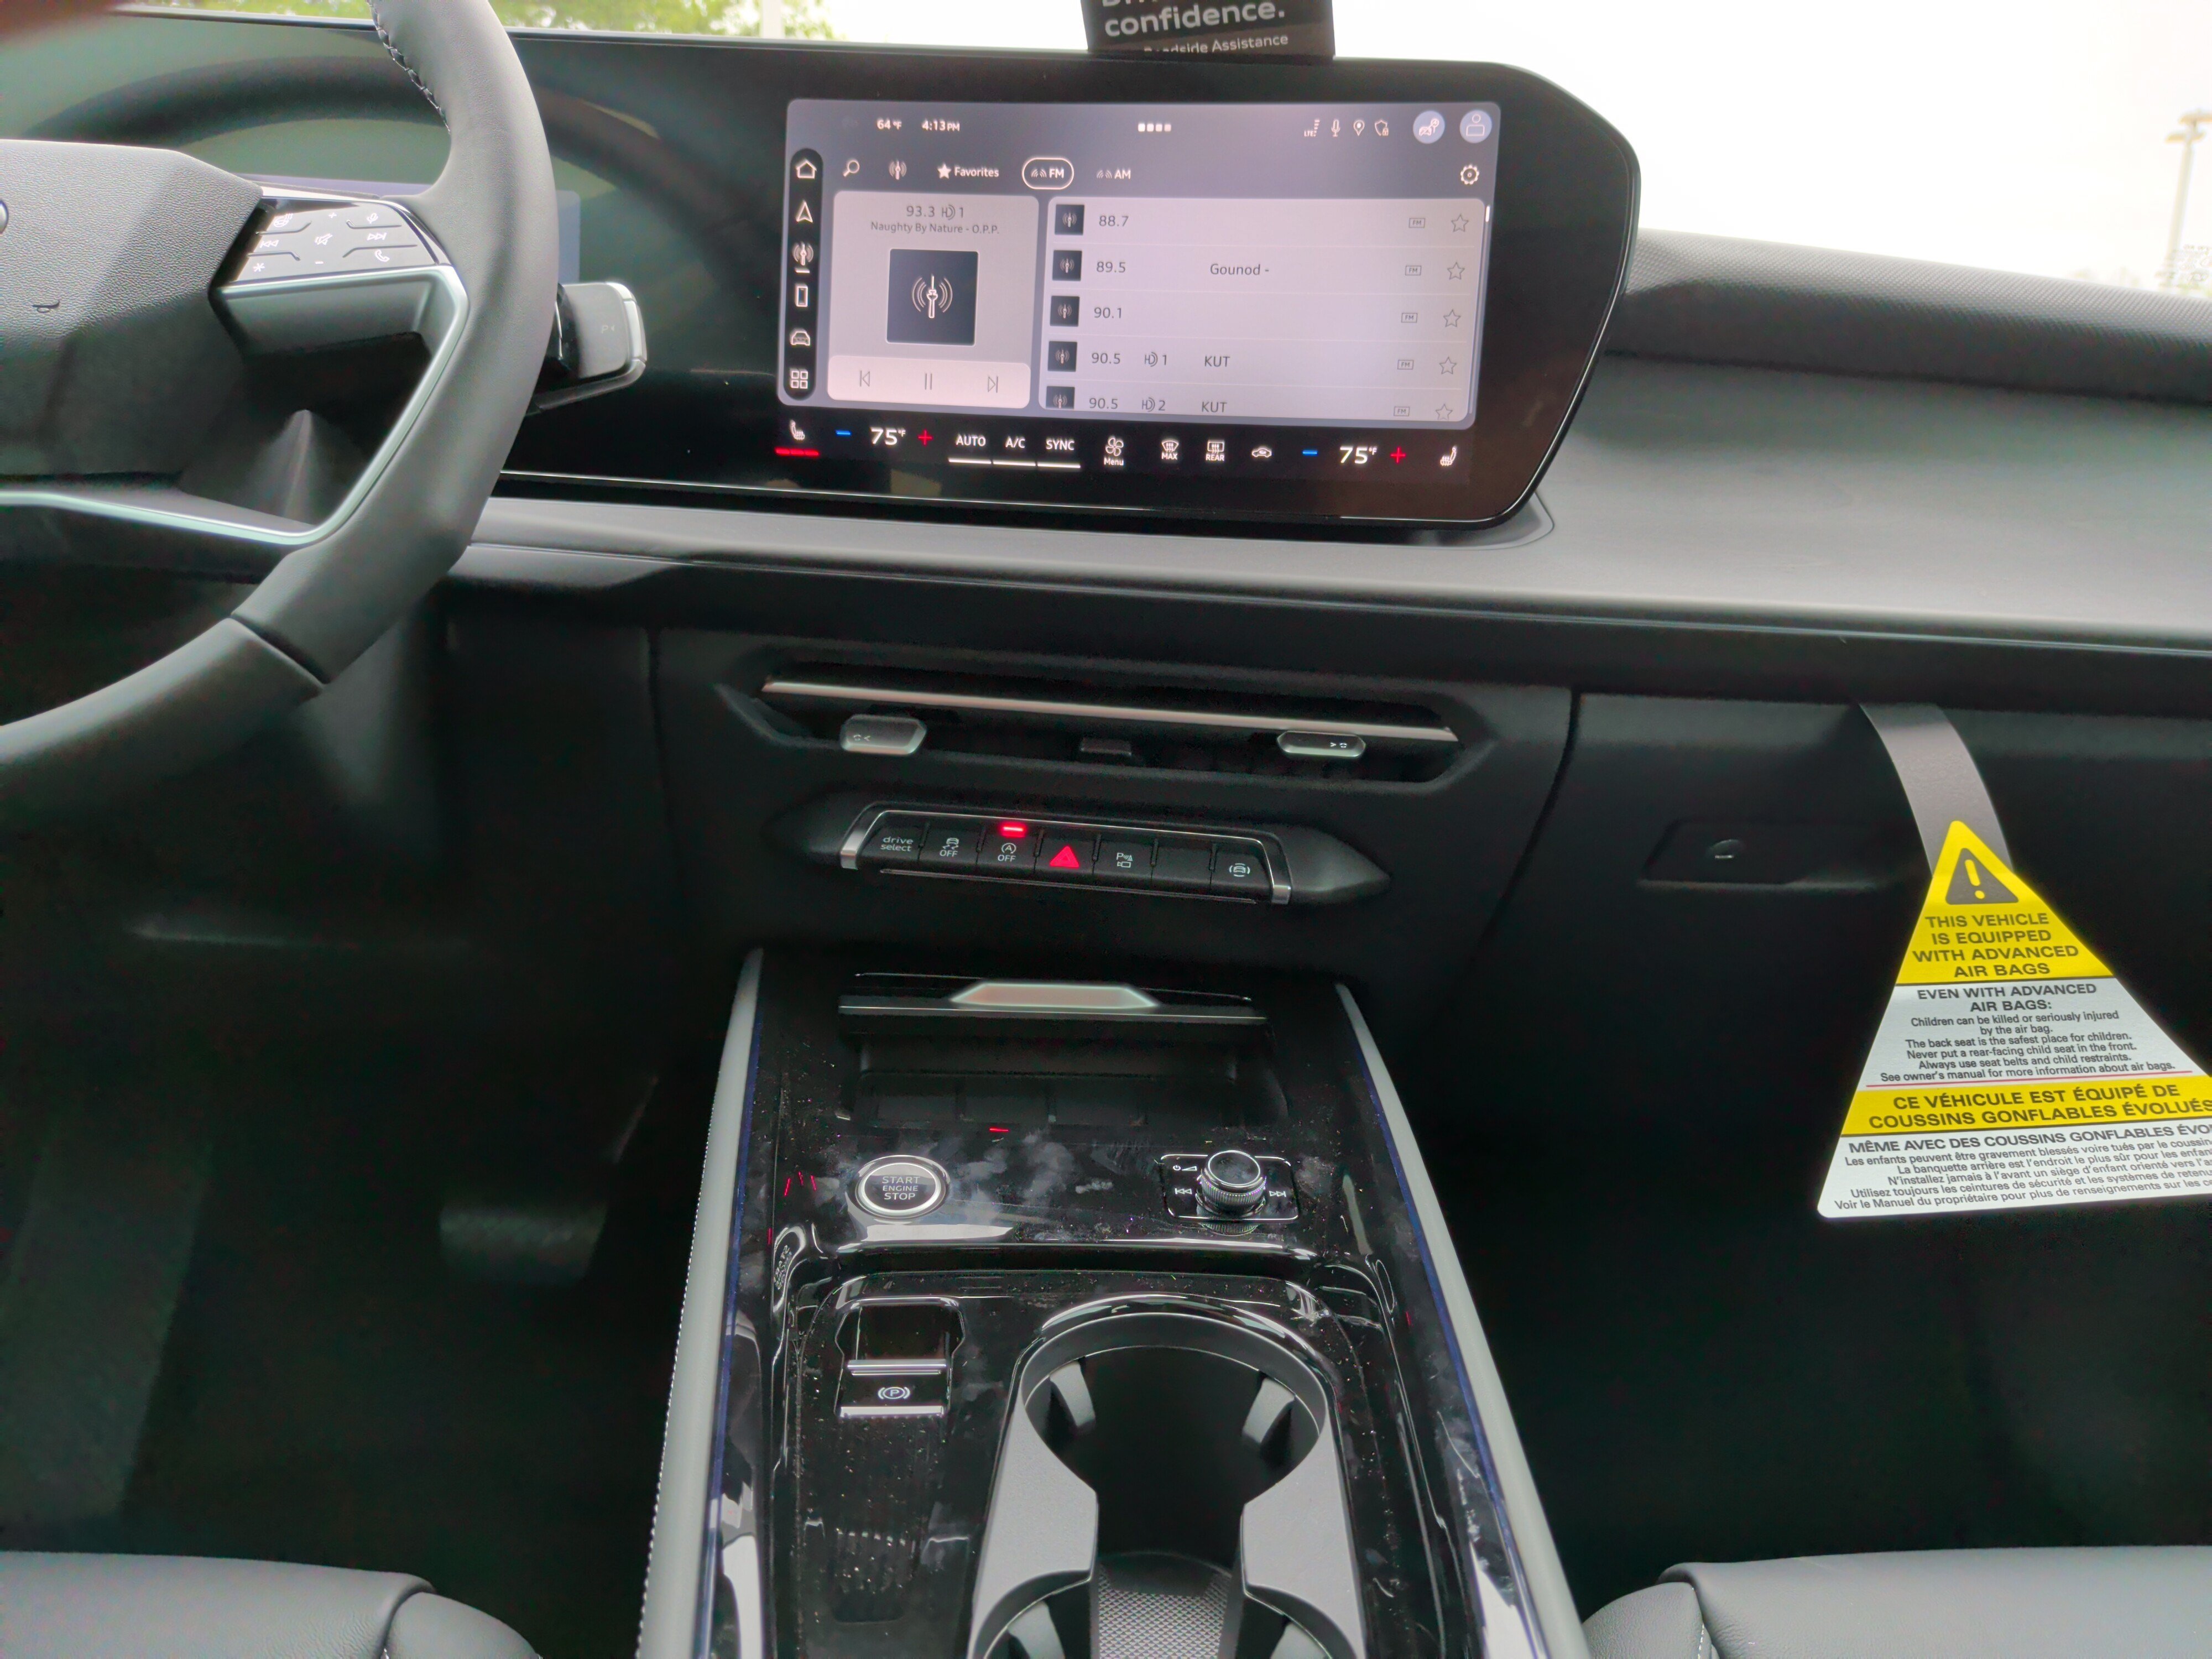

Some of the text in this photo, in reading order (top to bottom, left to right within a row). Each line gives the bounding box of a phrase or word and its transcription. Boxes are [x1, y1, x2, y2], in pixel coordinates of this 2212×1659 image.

[1105, 1, 1285, 36] confidence.
[1212, 35, 1288, 53] Assistance
[954, 166, 999, 178] Favorites
[1049, 169, 1064, 179] FM
[1114, 170, 1131, 180] AM
[906, 206, 935, 217] 93.3
[871, 222, 999, 234] Naughty By Nature O.P.P.
[1099, 216, 1129, 227] 88.7
[1096, 262, 1260, 275] 89.5 Gounod
[1094, 307, 1122, 319] 90.1
[1092, 353, 1120, 364] 90.5
[1204, 356, 1230, 367] KUT
[1089, 398, 1118, 409] 90.5
[1202, 401, 1227, 413] KUT
[956, 435, 986, 447] AUTO
[1005, 437, 1025, 448] A/C
[1046, 439, 1074, 451] SYNC
[883, 836, 913, 844] drive
[1925, 913, 2049, 928] THIS VEHICLE
[1932, 930, 2051, 945] IS EQUIPPED
[1912, 946, 2079, 962] WITH ADVANCED
[1954, 963, 2050, 977] AIR BAGS
[1917, 984, 2096, 1000] EVEN WITH ADVANCED
[1970, 1000, 2052, 1012] AIR BAGS:
[1911, 1017, 1953, 1027] Children
[1977, 1016, 1990, 1024] be
[1992, 1015, 2018, 1023] killed
[2036, 1012, 2080, 1022] seriously
[2084, 1010, 2119, 1021] injured
[1980, 1027, 1992, 1036] by
[2031, 1025, 2053, 1034] bag.
[1906, 1039, 1926, 1048] The
[1929, 1039, 1952, 1047] back
[1955, 1038, 1975, 1046] seat
[2008, 1036, 2038, 1044] safest
[2042, 1035, 2068, 1045] place
[2088, 1032, 2132, 1041] children.
[1907, 1050, 1937, 1059] Never
[1941, 1050, 1957, 1060] put
[1969, 1047, 2024, 1056] rear-facing
[2027, 1046, 2052, 1055] child
[2054, 1045, 2074, 1053] seat
[2108, 1042, 2136, 1050] front.
[1919, 1061, 1956, 1070] Always
[2004, 1057, 2028, 1066] belts
[2031, 1055, 2050, 1065] and
[2053, 1055, 2078, 1063] child
[2080, 1053, 2131, 1063] restraints.
[1881, 1073, 1900, 1082] See
[1948, 1069, 1985, 1079] manual
[1988, 1068, 2002, 1077] for
[2007, 1068, 2033, 1077] more
[2036, 1065, 2096, 1076] information
[2099, 1063, 2128, 1073] about
[2131, 1062, 2144, 1071] air
[2147, 1060, 2176, 1071] bags.
[1893, 1083, 2180, 1110] CE VÉHICULE EST ÉQUIPÉ DE
[1869, 1098, 2212, 1129] COUSSINS GONFLABLES ÉVOLUÉS
[1849, 1140, 1900, 1153] MÊME
[1905, 1139, 1946, 1150] AVEC
[1949, 1138, 1980, 1148] DES
[1984, 1133, 2066, 1146] COUSSINS
[2070, 1126, 2174, 1142] GONFLABLES
[1845, 1142, 2154, 1166] Les enfants peuvent être gravement blessés voire tués par
[1897, 1165, 1911, 1174] La
[1913, 1164, 1968, 1175] banquette
[1971, 1161, 2006, 1171] arrière
[2009, 1160, 2025, 1168] est
[2088, 1154, 2111, 1165] plus
[2133, 1152, 2158, 1162] pour
[1947, 1160, 2194, 1184] jamais siège orienté vers
[1851, 1173, 2158, 1198] Utilisez toujours ceintures sécurité systèmes
[1834, 1200, 1858, 1209] Voir
[1874, 1197, 1914, 1207] Manuel
[1934, 1193, 1998, 1206] propriétaire
[2001, 1191, 2026, 1202] pour
[2030, 1190, 2053, 1200] plus
[2073, 1181, 2162, 1194] renseignements
